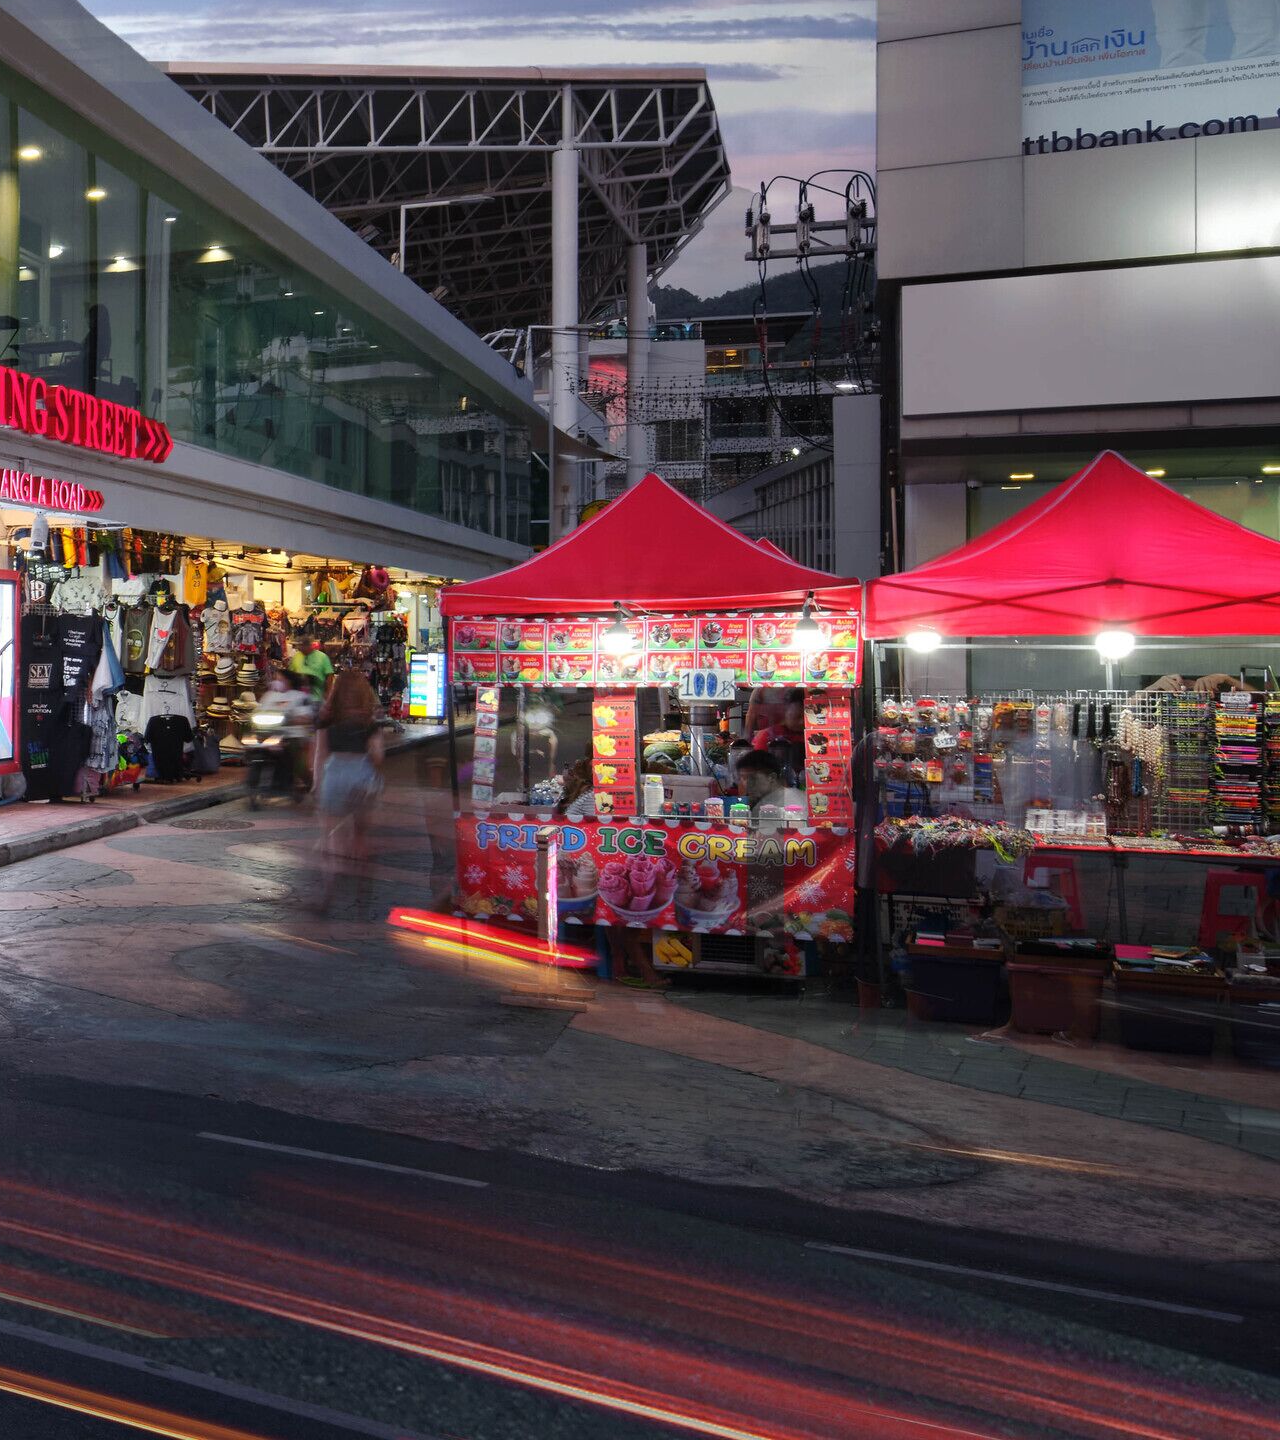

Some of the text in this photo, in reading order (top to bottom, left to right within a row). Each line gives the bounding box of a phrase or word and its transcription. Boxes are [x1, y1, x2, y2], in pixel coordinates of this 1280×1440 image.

[1022, 114, 1259, 156] ttbbank.com
[53, 385, 141, 460] STREET
[50, 479, 87, 512] ROAD
[30, 665, 51, 678] SEX
[681, 671, 718, 698] 100
[597, 826, 668, 857] ICE
[677, 833, 817, 867] CREAM
